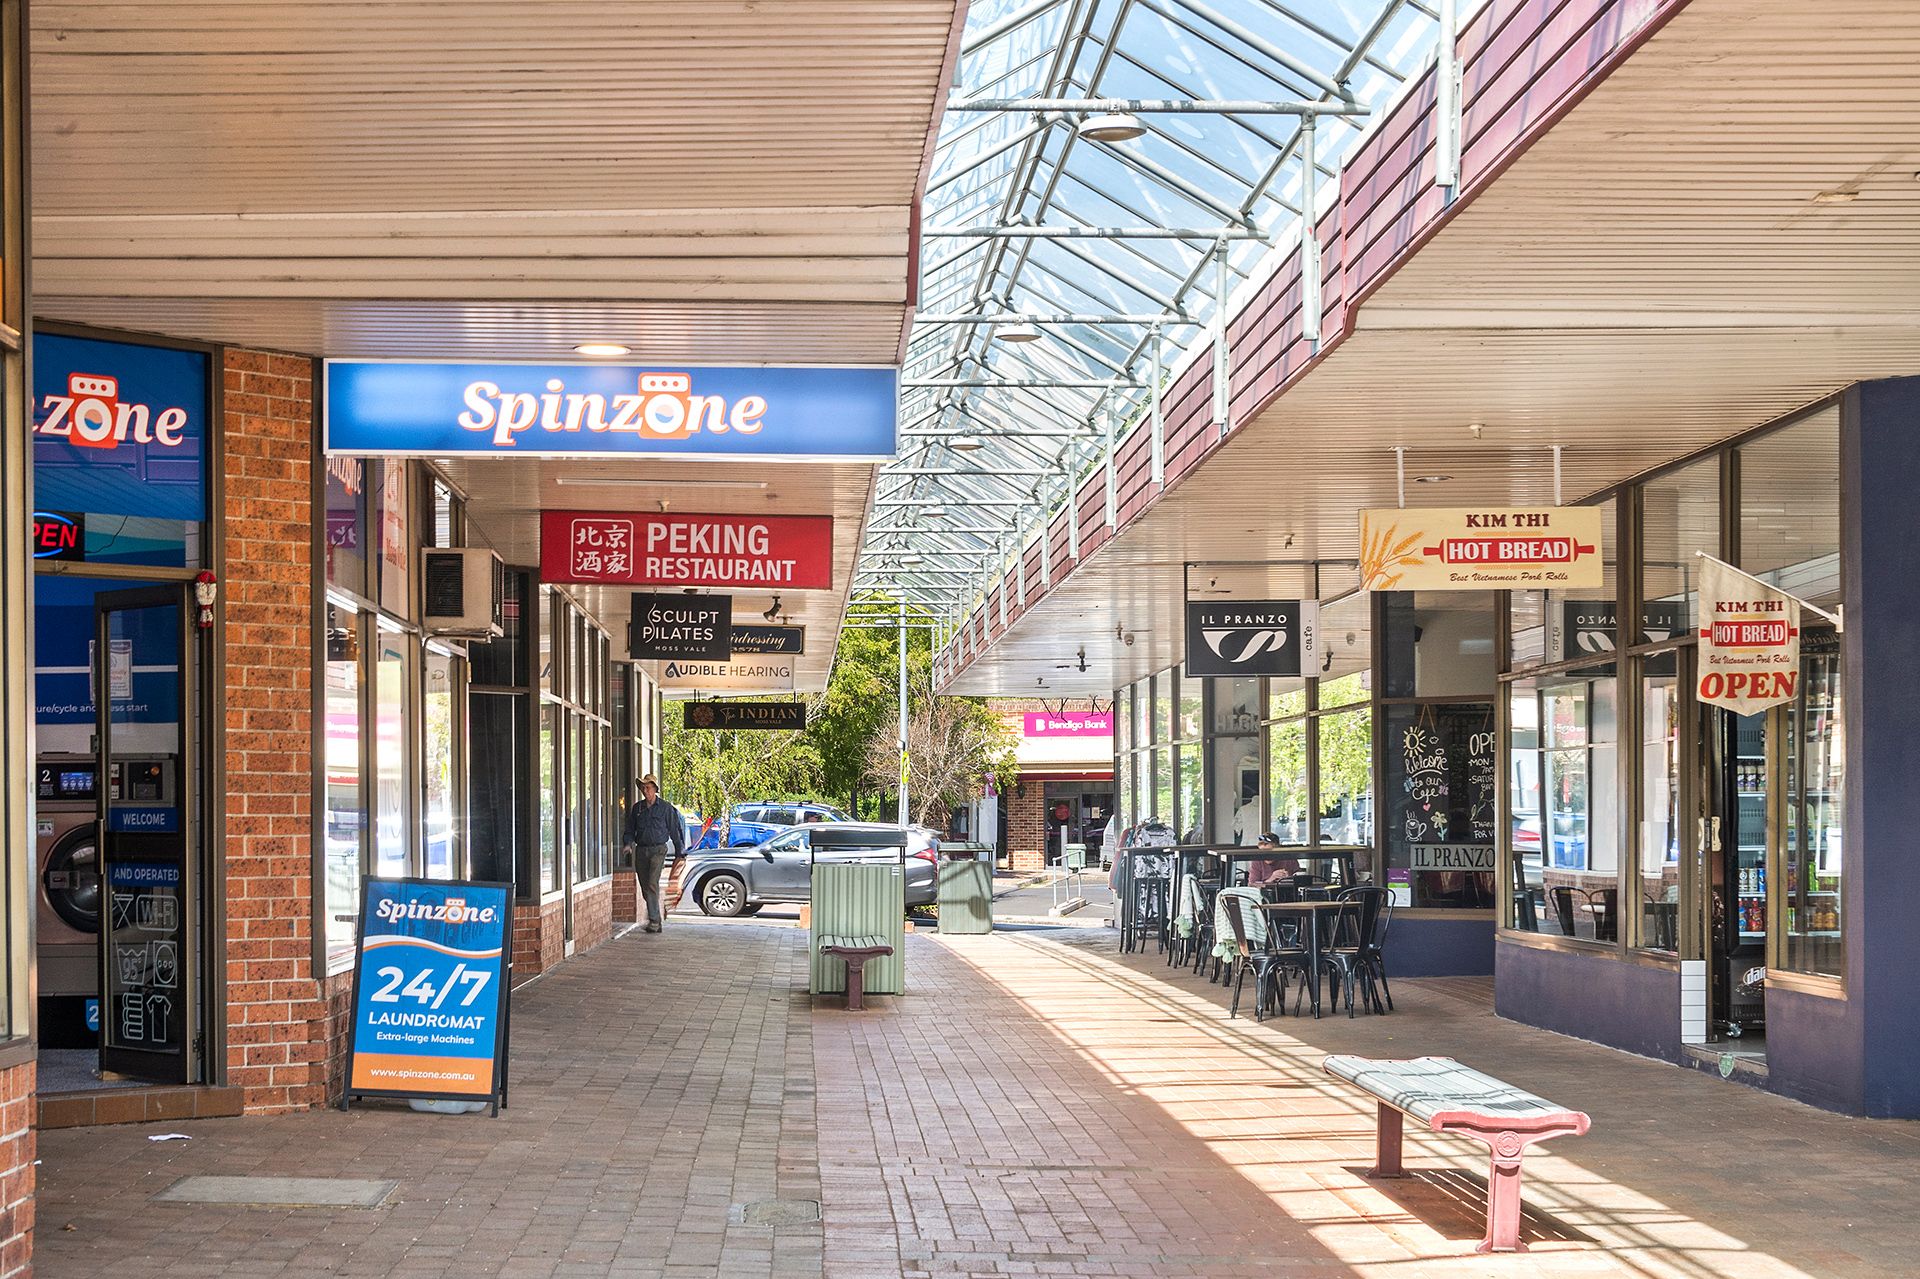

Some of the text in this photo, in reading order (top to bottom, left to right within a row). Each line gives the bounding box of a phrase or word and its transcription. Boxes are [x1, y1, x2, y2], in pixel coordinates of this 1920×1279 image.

[458, 374, 767, 447] Spinzone
[33, 393, 188, 447] zone
[1466, 513, 1550, 528] KIM THI
[575, 522, 628, 548] 北京
[647, 522, 770, 556] PEKING
[1449, 540, 1569, 560] HOT BREAD
[575, 550, 630, 575] 酒家
[646, 557, 797, 582] RESTAURANT
[1450, 571, 1569, 582] Best Vietnamese Pork Rolls
[1715, 600, 1784, 613] KIM THI
[652, 610, 720, 624] SCULPT
[1201, 614, 1288, 624] IL PRANZO
[642, 626, 714, 641] PILATES
[1303, 625, 1313, 651] cafe
[1714, 625, 1738, 643] HOT
[1742, 624, 1785, 643] BREAD
[1756, 654, 1772, 664] Pork
[1773, 653, 1791, 663] Rolls
[665, 662, 790, 678] AUDIBLE HEARING
[1700, 671, 1798, 699] OPEN
[740, 708, 798, 719] INDIAN
[1048, 719, 1083, 731] Bendigo
[1085, 719, 1107, 730] Bank
[1470, 732, 1495, 756] OPE
[42, 769, 51, 782] 2
[123, 813, 166, 826] WELCOME
[1414, 846, 1495, 868] IL PRANZO
[114, 868, 180, 882] AND OPERATED
[376, 897, 495, 924] Spinzone
[370, 963, 492, 1010] 24/7
[368, 1011, 486, 1030] LAUNDROMAT
[376, 1031, 475, 1045] Extra-large Machines
[370, 1069, 475, 1082] www.spinzone.com.au
